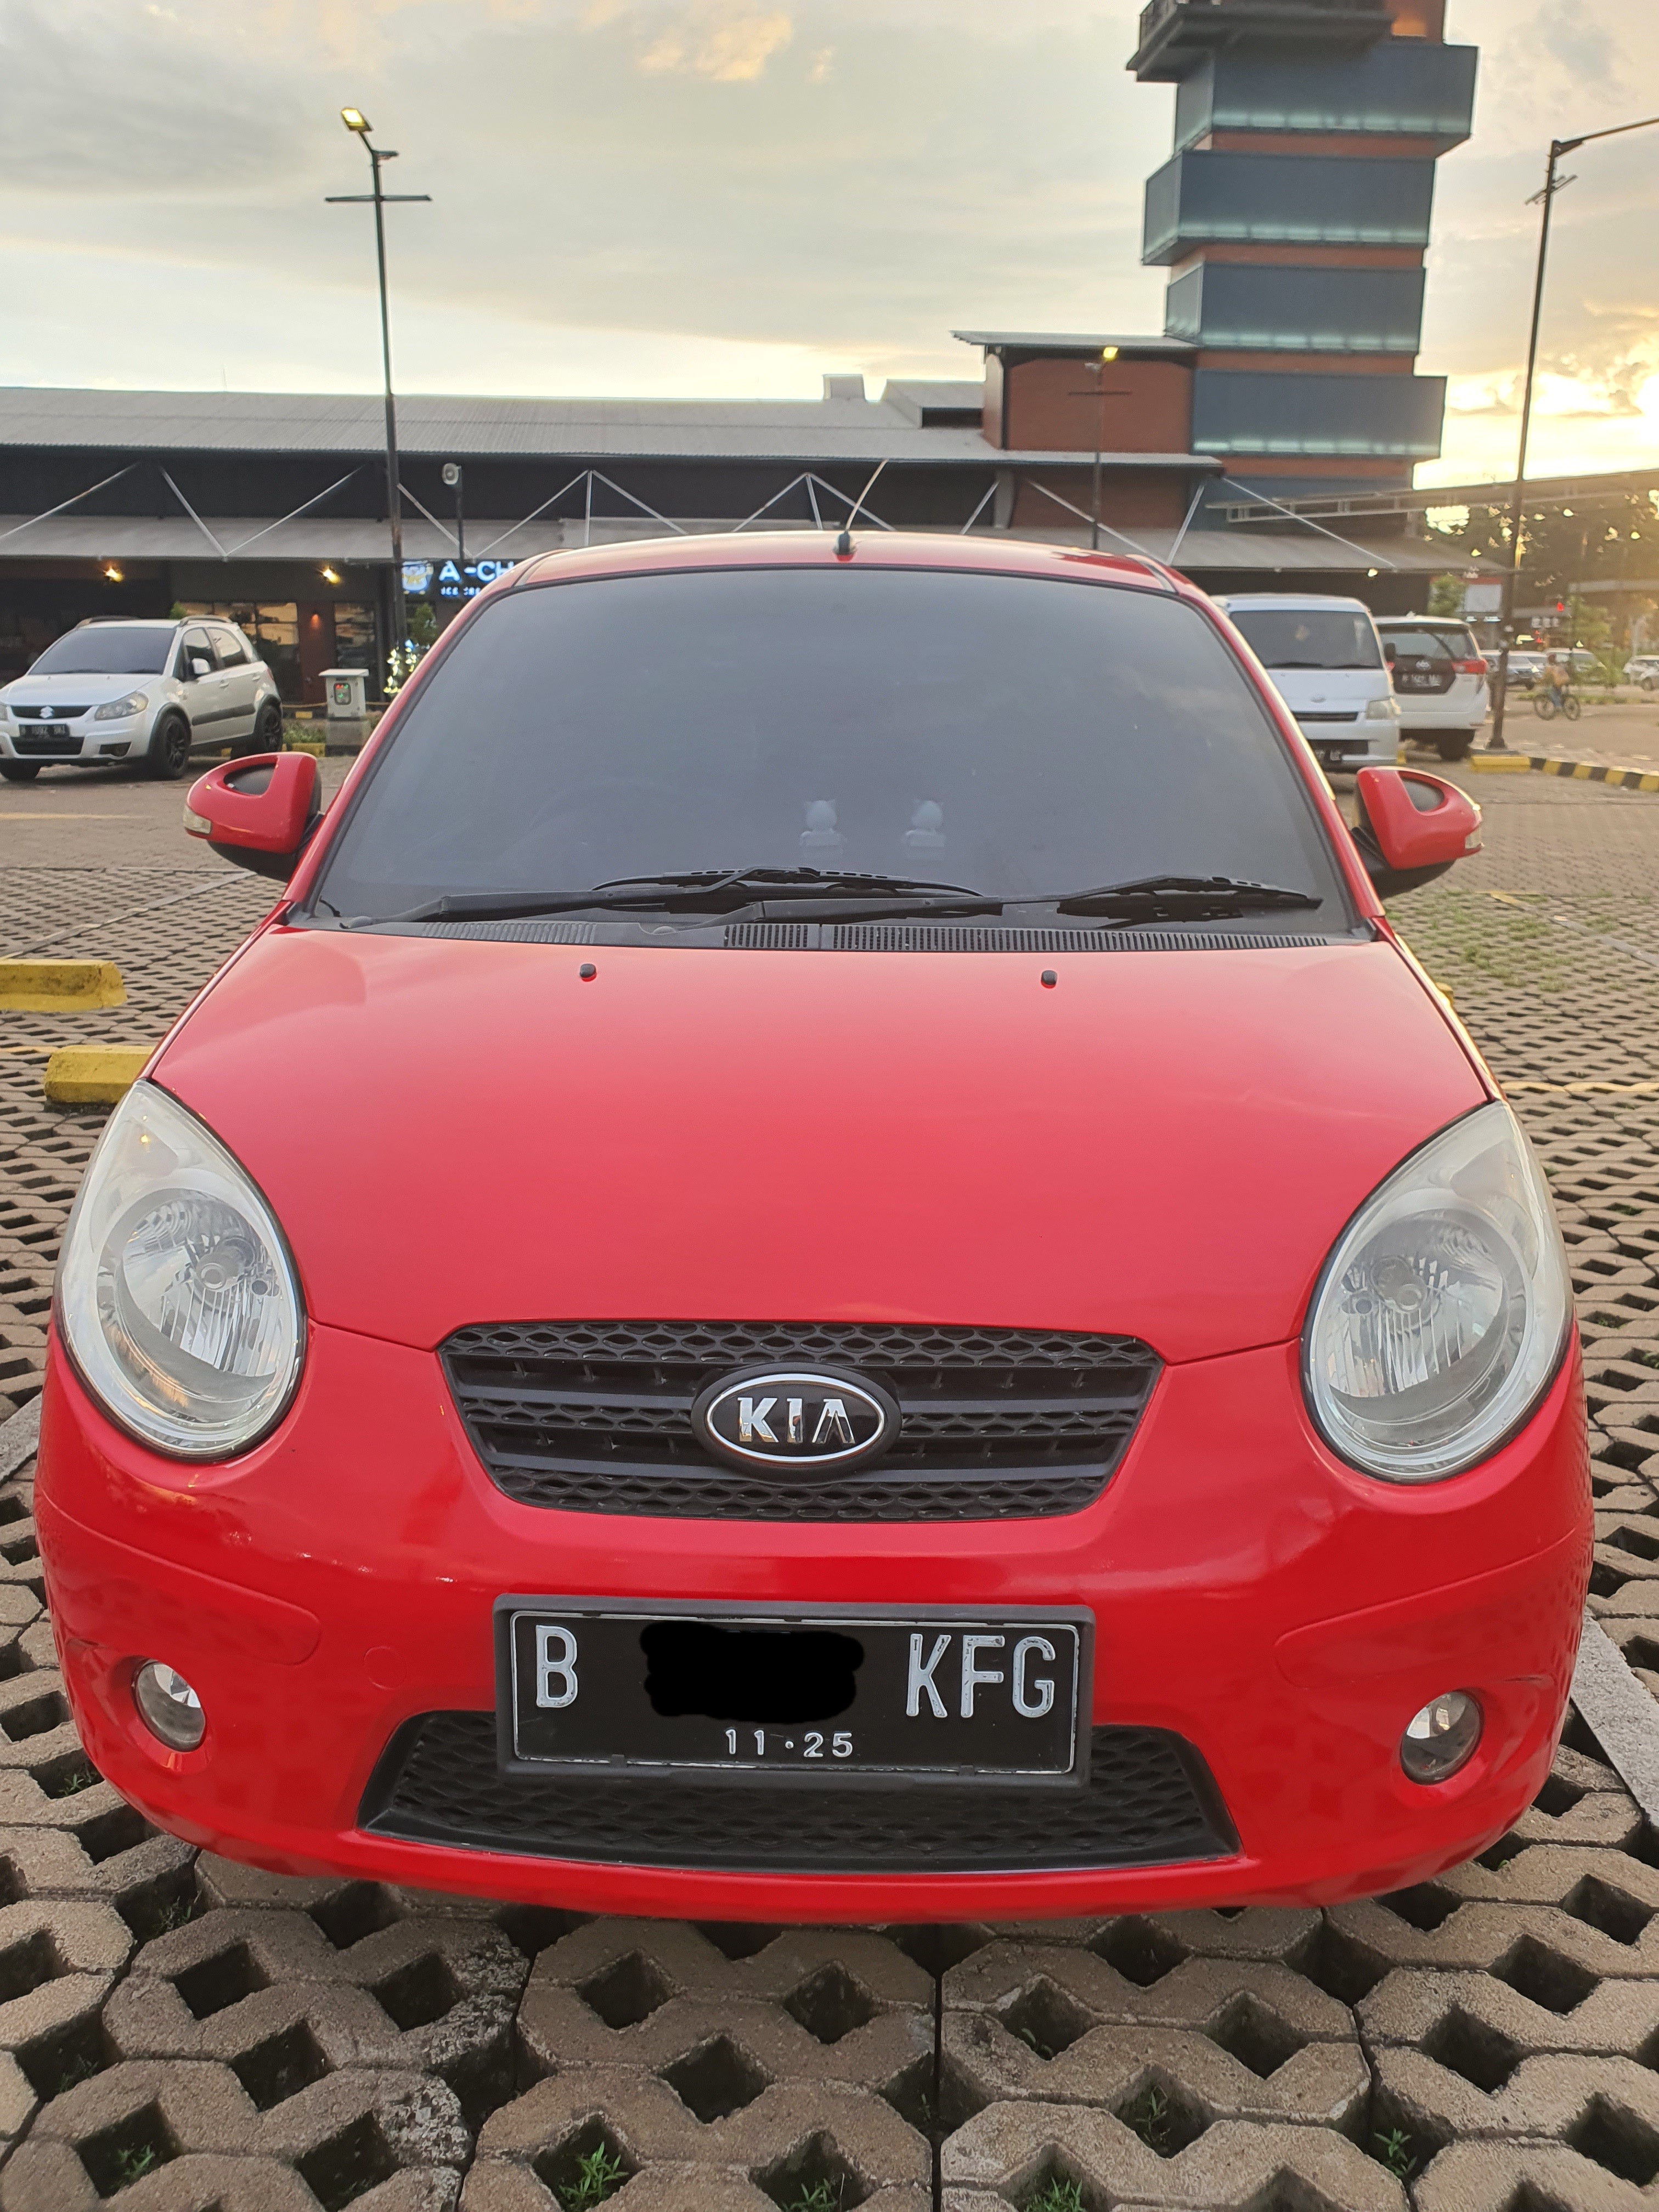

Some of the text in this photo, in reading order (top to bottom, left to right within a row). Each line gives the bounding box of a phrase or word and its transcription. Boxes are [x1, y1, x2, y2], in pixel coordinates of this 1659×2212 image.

[737, 1397, 856, 1444] KIA
[535, 1624, 1056, 1718] B KFG
